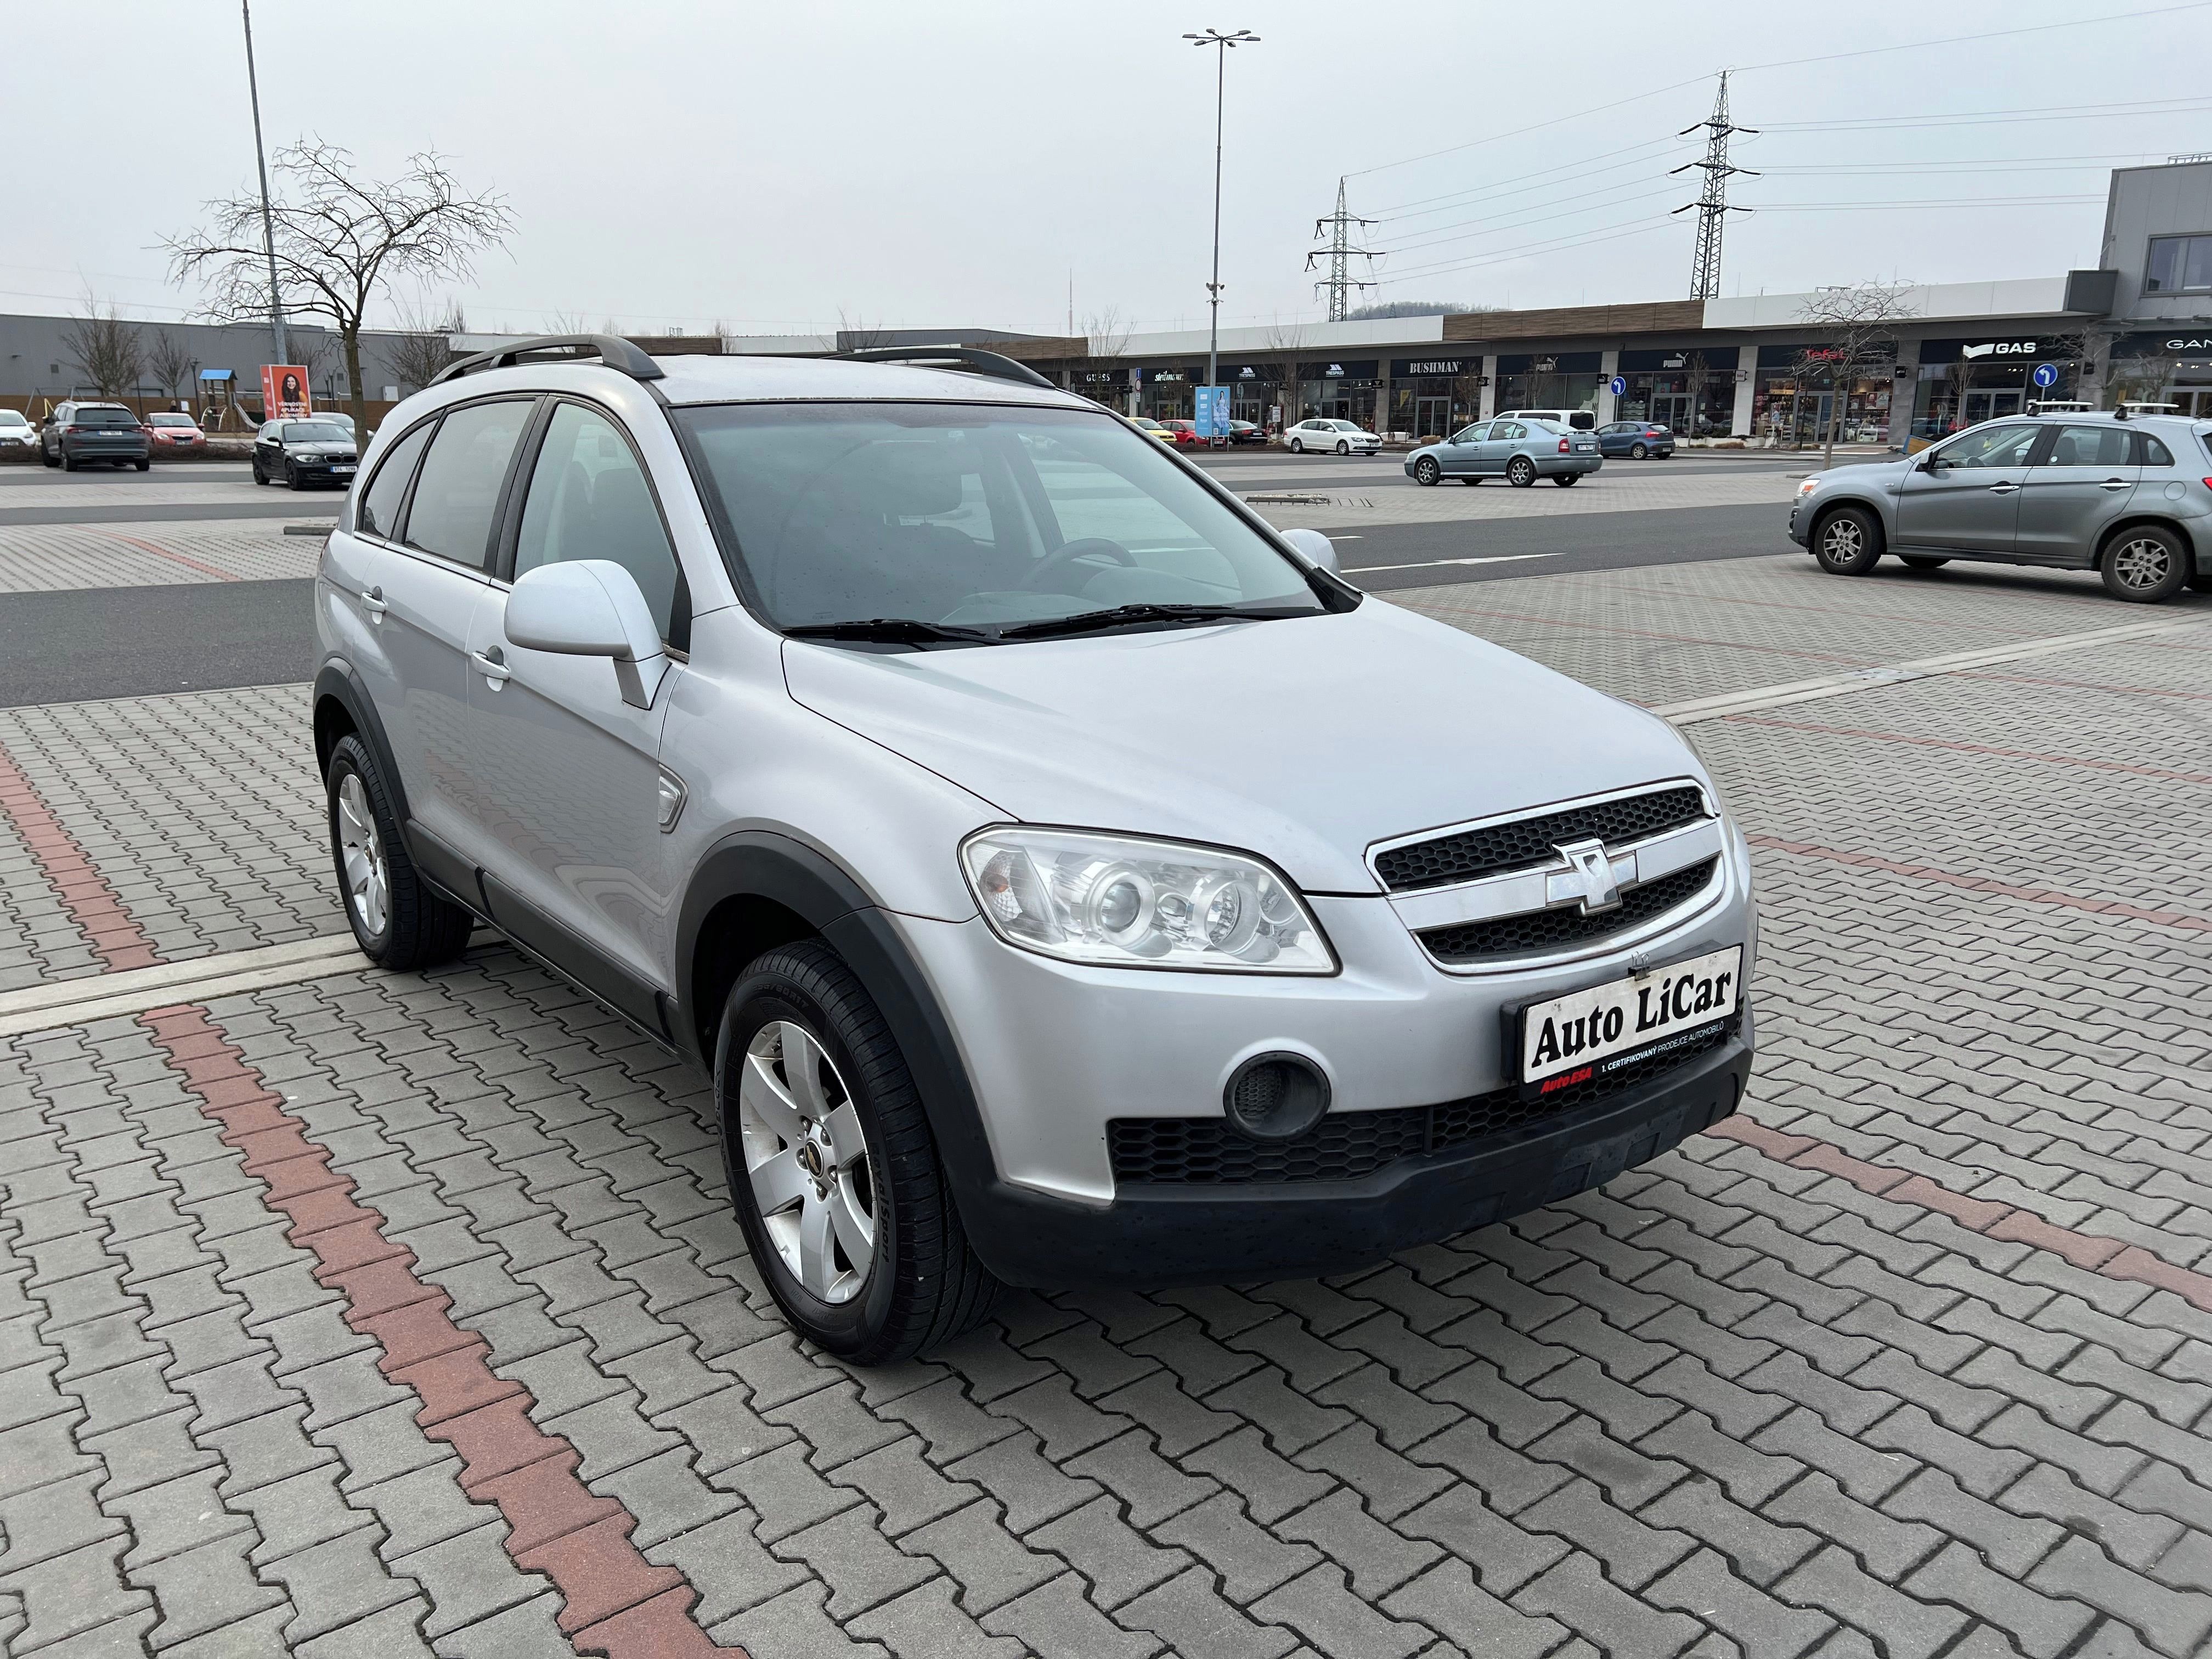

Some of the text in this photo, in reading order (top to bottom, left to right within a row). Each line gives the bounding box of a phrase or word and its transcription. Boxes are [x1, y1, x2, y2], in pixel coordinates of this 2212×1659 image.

[1996, 342, 2037, 354] GAS
[1409, 361, 1459, 374] BUSHMAN
[1531, 971, 1731, 1068] Auto LiCar
[1607, 1046, 1657, 1070] CERTIFIKOVANÝ
[1657, 1035, 1689, 1053] PRODEJCE
[1688, 1020, 1724, 1042] AUTOMOBILŮ
